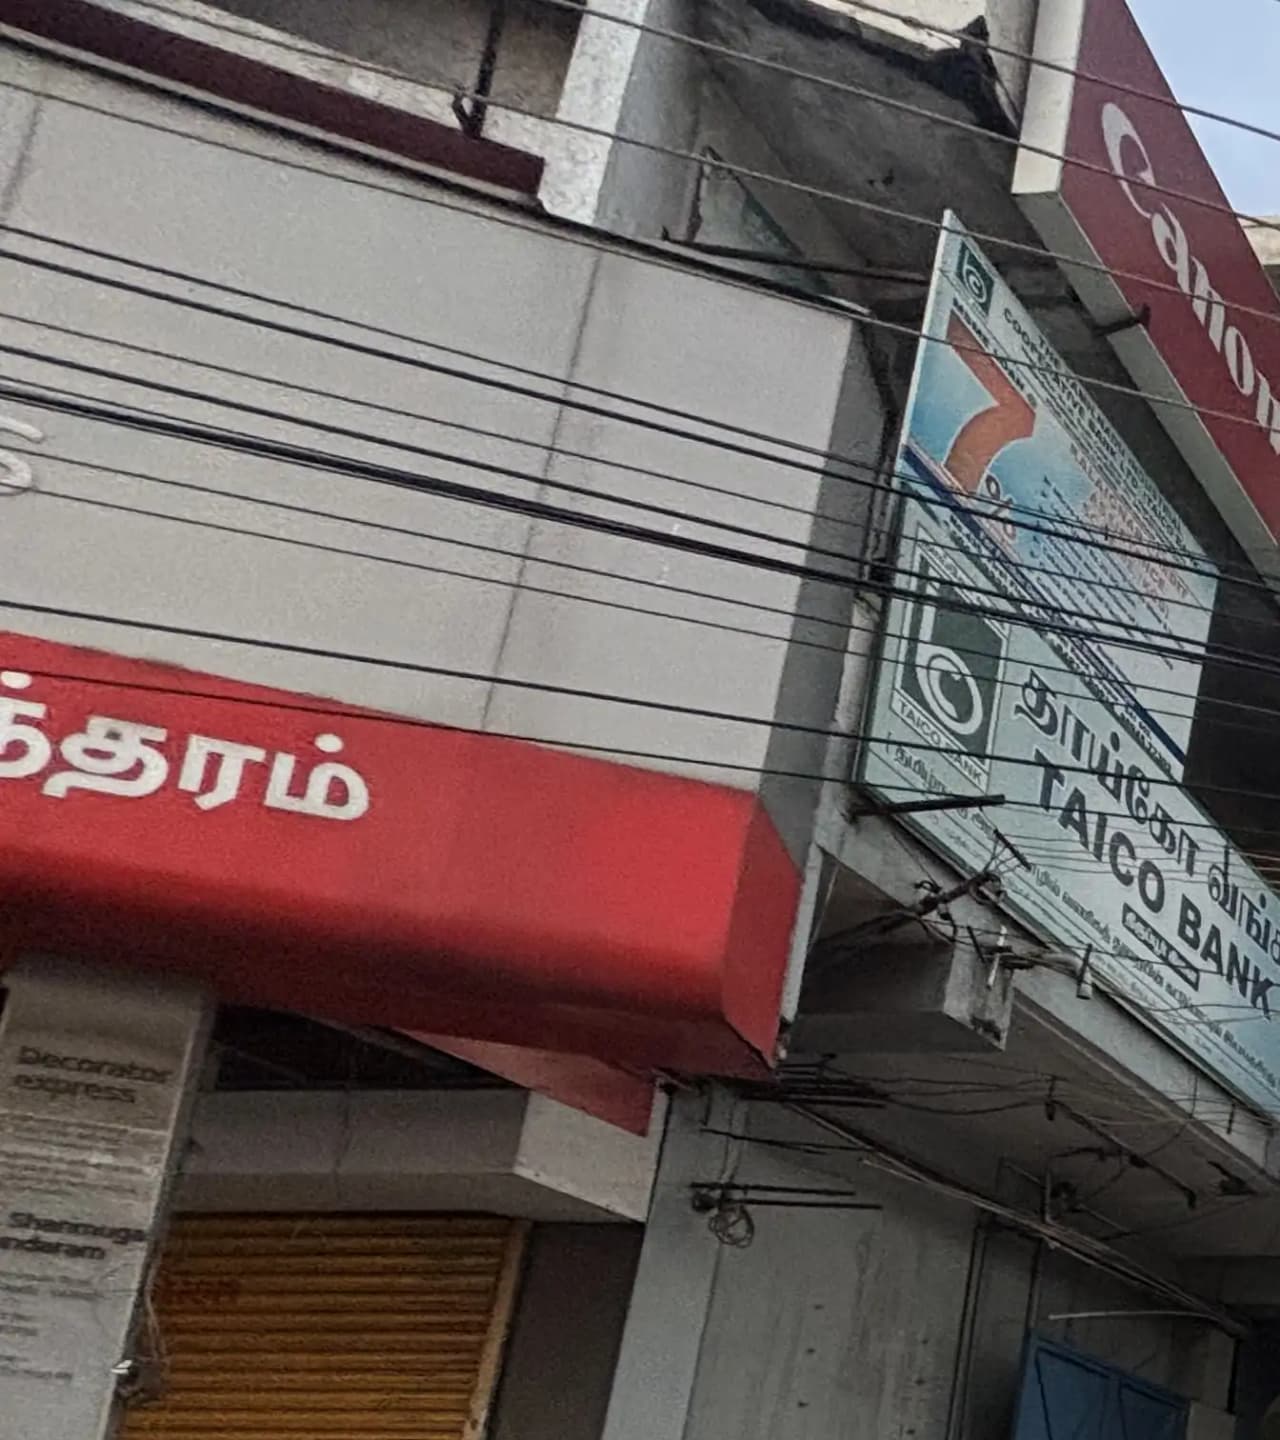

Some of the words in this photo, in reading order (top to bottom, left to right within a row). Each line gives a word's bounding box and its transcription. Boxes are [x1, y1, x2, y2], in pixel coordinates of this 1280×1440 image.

[1013, 638, 1204, 888] தாய்கோ
[1026, 744, 1168, 921] TAICO
[1176, 891, 1276, 1024] BANK
[14, 1074, 135, 1103] express
[19, 1046, 173, 1084] Decorator
